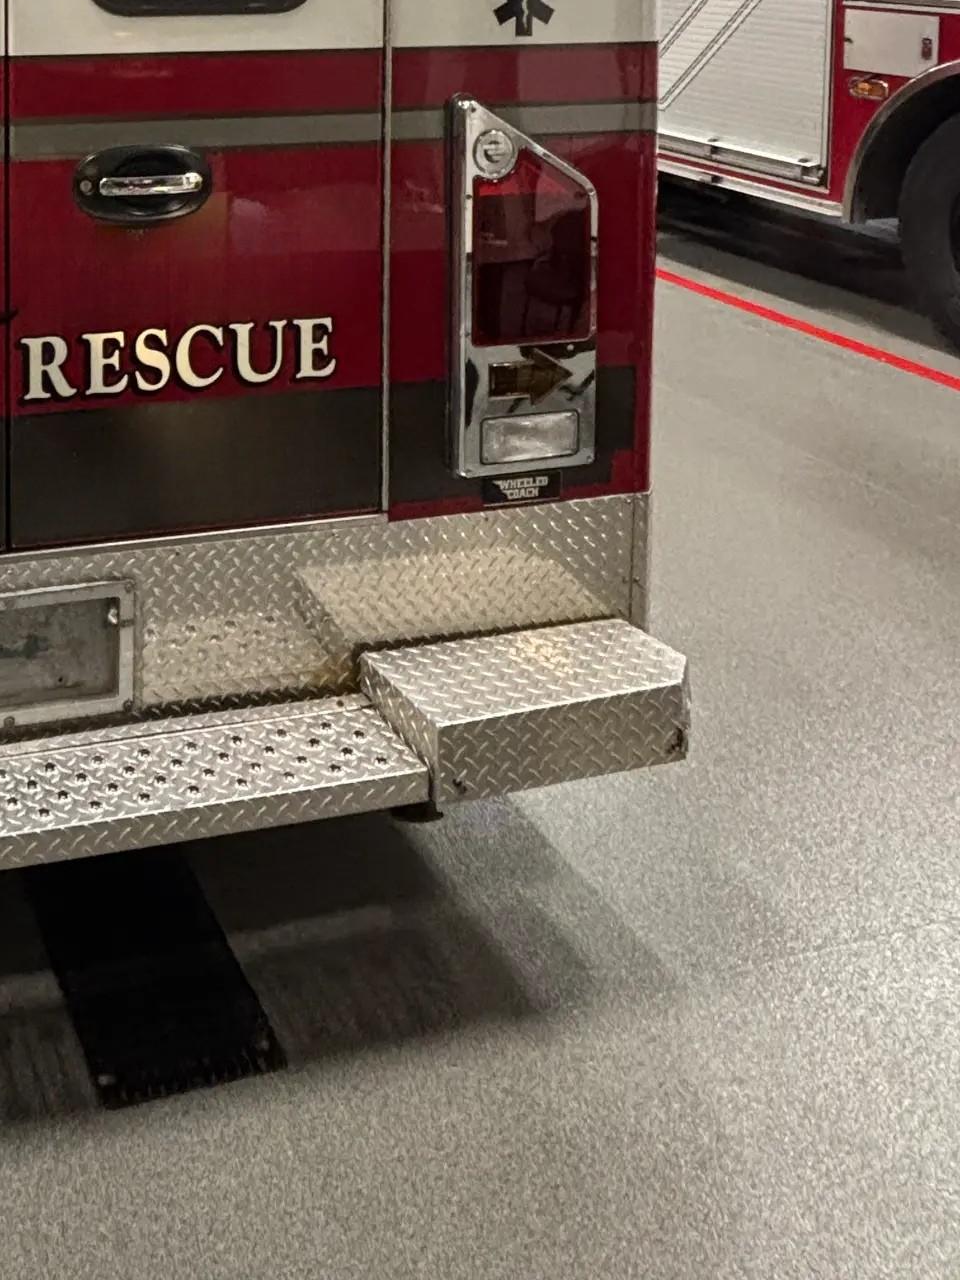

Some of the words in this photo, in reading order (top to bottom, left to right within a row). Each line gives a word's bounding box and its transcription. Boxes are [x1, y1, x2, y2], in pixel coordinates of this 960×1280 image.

[19, 316, 338, 401] RESCUE
[493, 475, 549, 490] WHEELED
[503, 487, 540, 500] COACH
